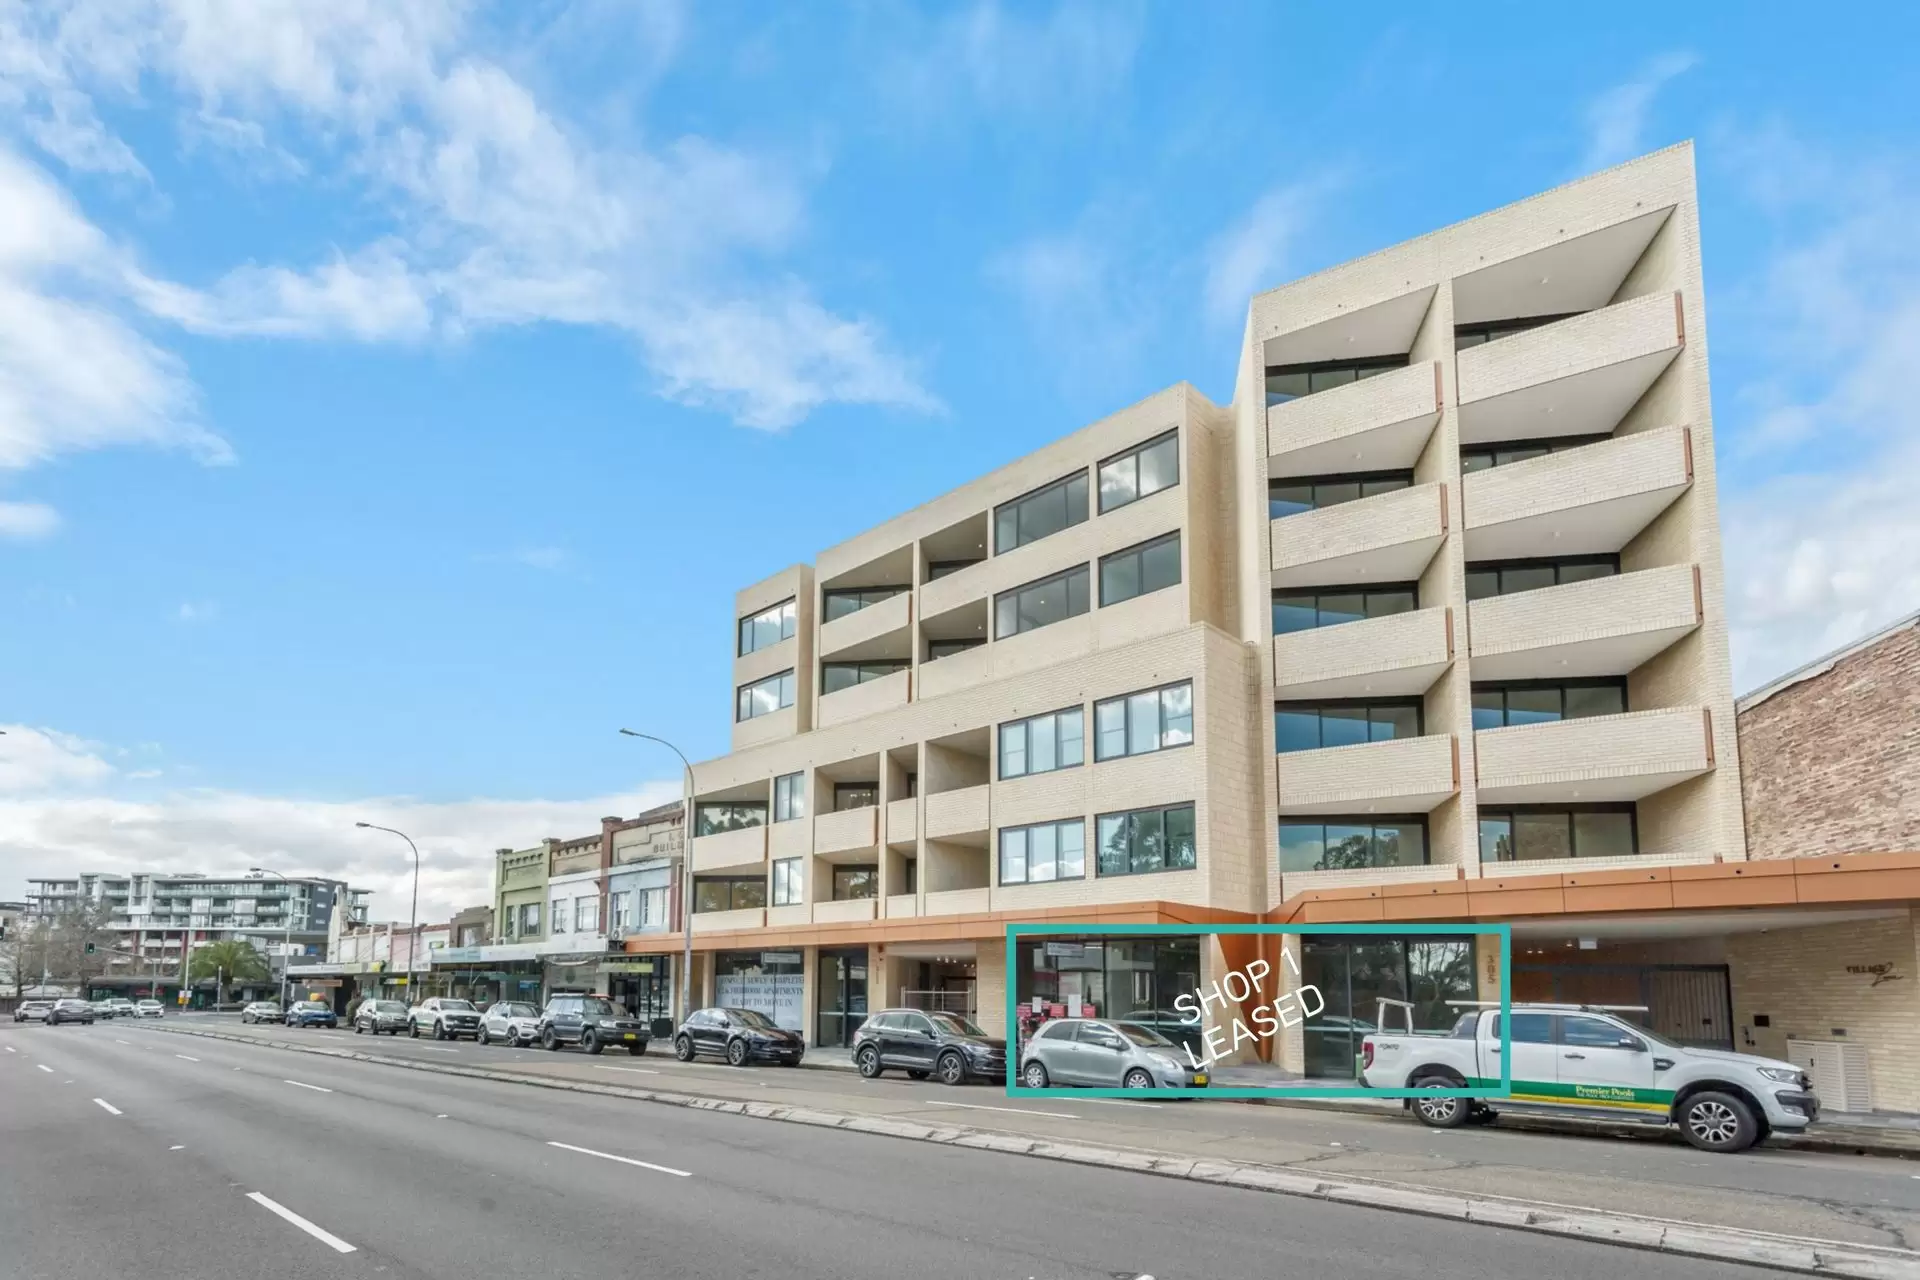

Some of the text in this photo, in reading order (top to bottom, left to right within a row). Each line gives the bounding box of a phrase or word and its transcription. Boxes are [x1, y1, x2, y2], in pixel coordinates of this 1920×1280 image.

[732, 998, 793, 1007] READY TO MOVE IN
[1575, 1085, 1635, 1097] Premier Pools
